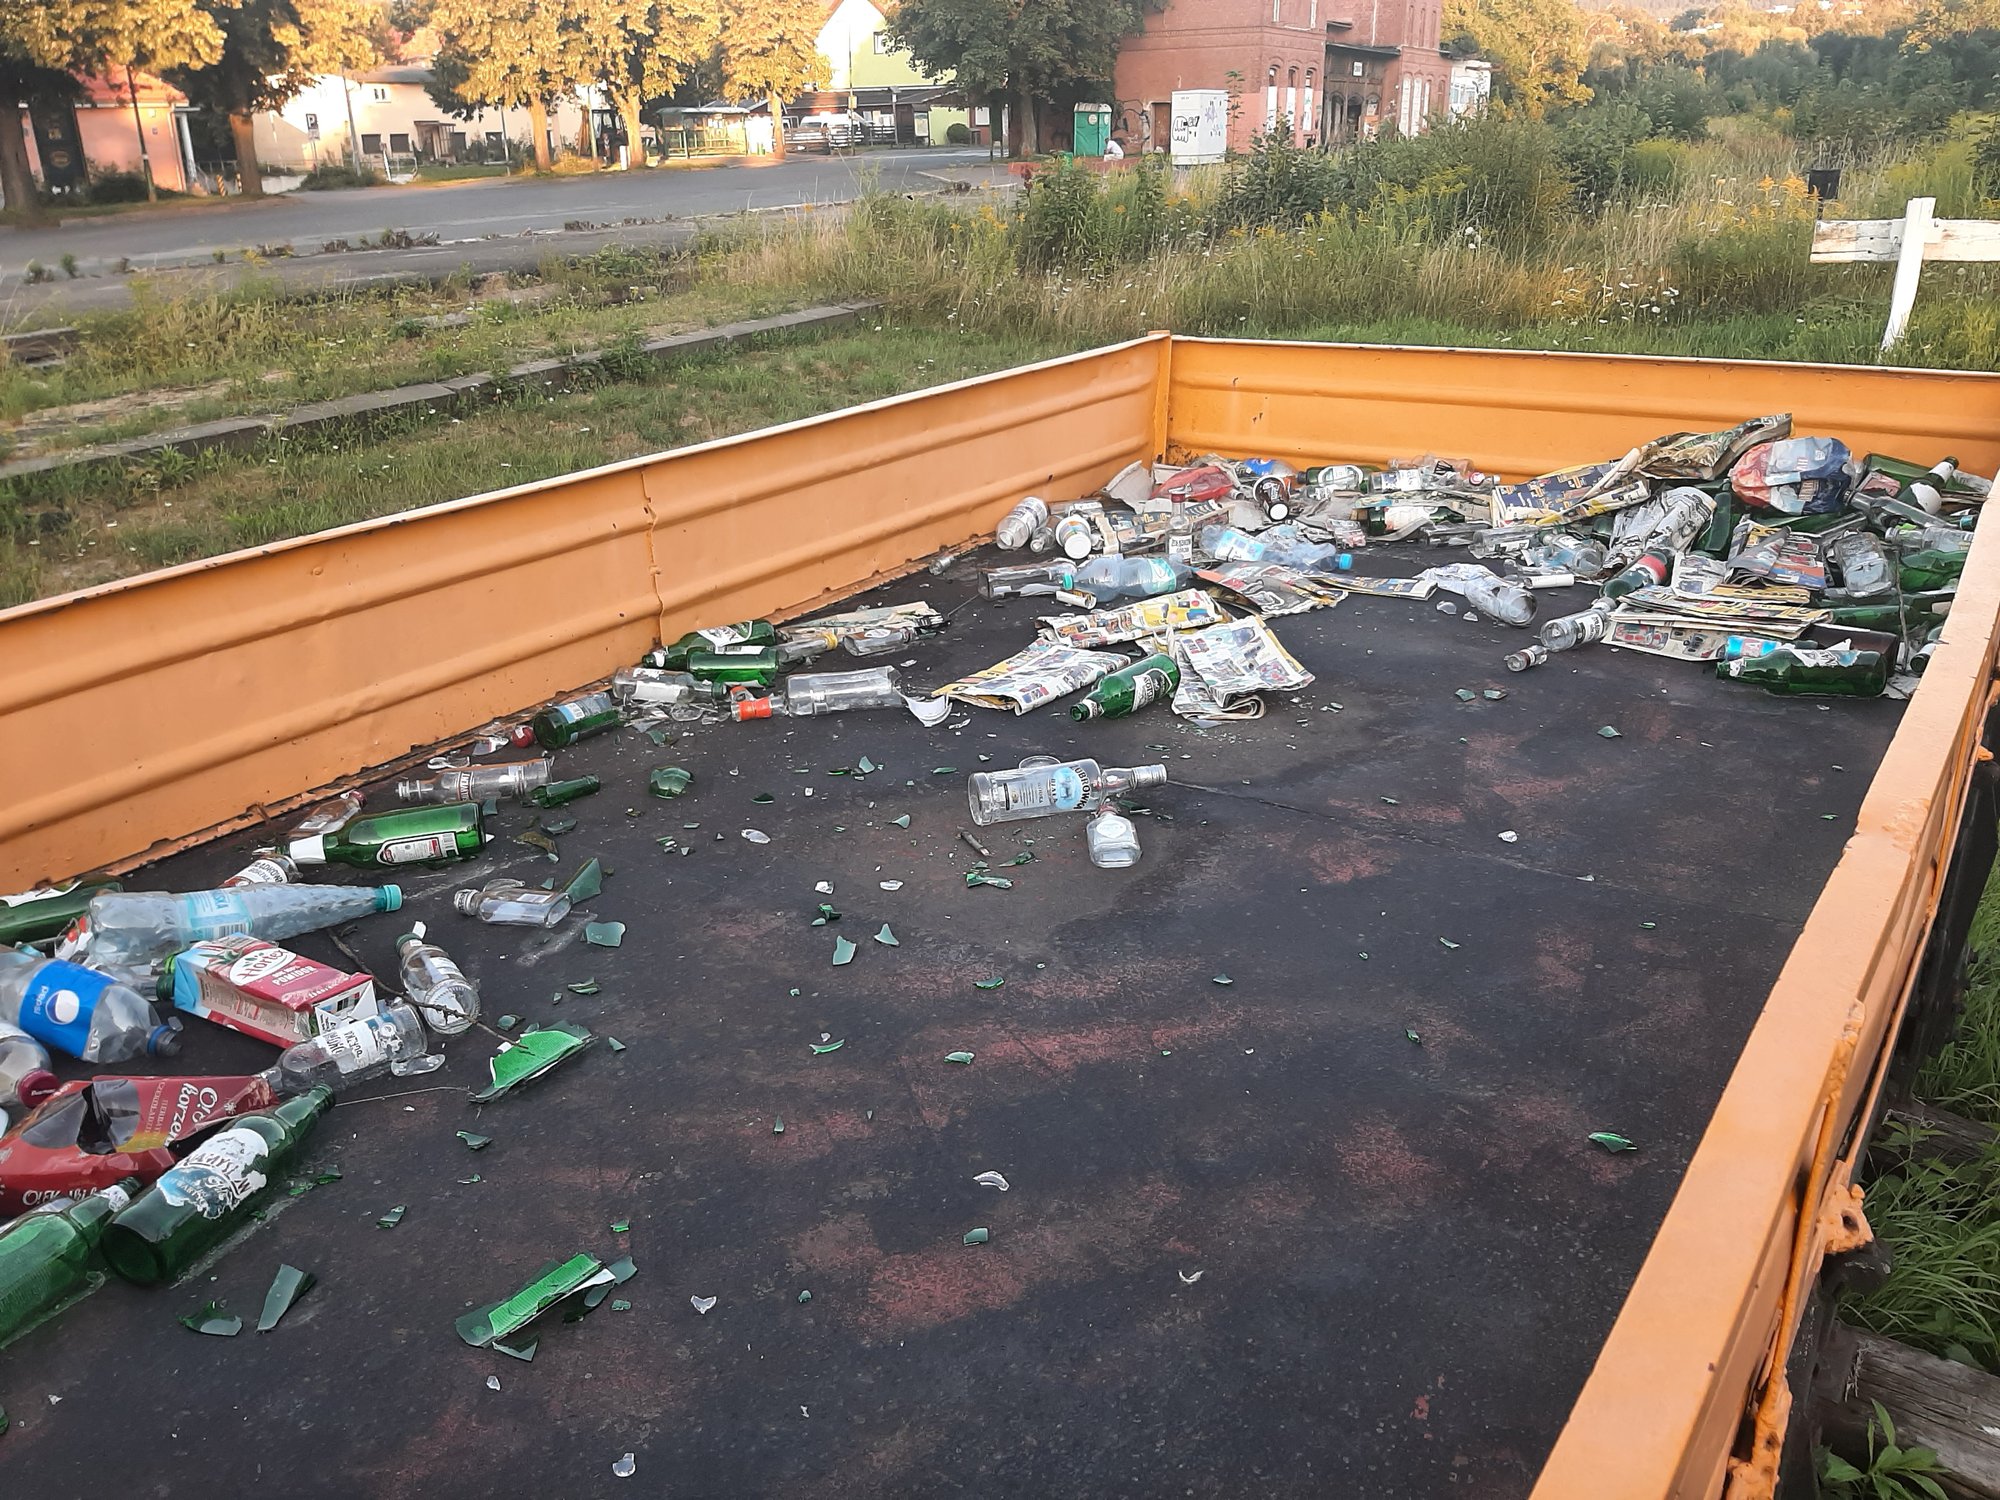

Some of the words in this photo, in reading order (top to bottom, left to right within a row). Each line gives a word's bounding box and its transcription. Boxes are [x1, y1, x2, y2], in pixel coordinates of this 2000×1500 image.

[238, 949, 288, 980] Hortex
[272, 966, 317, 986] POMIDOR
[33, 985, 49, 1015] pepsi
